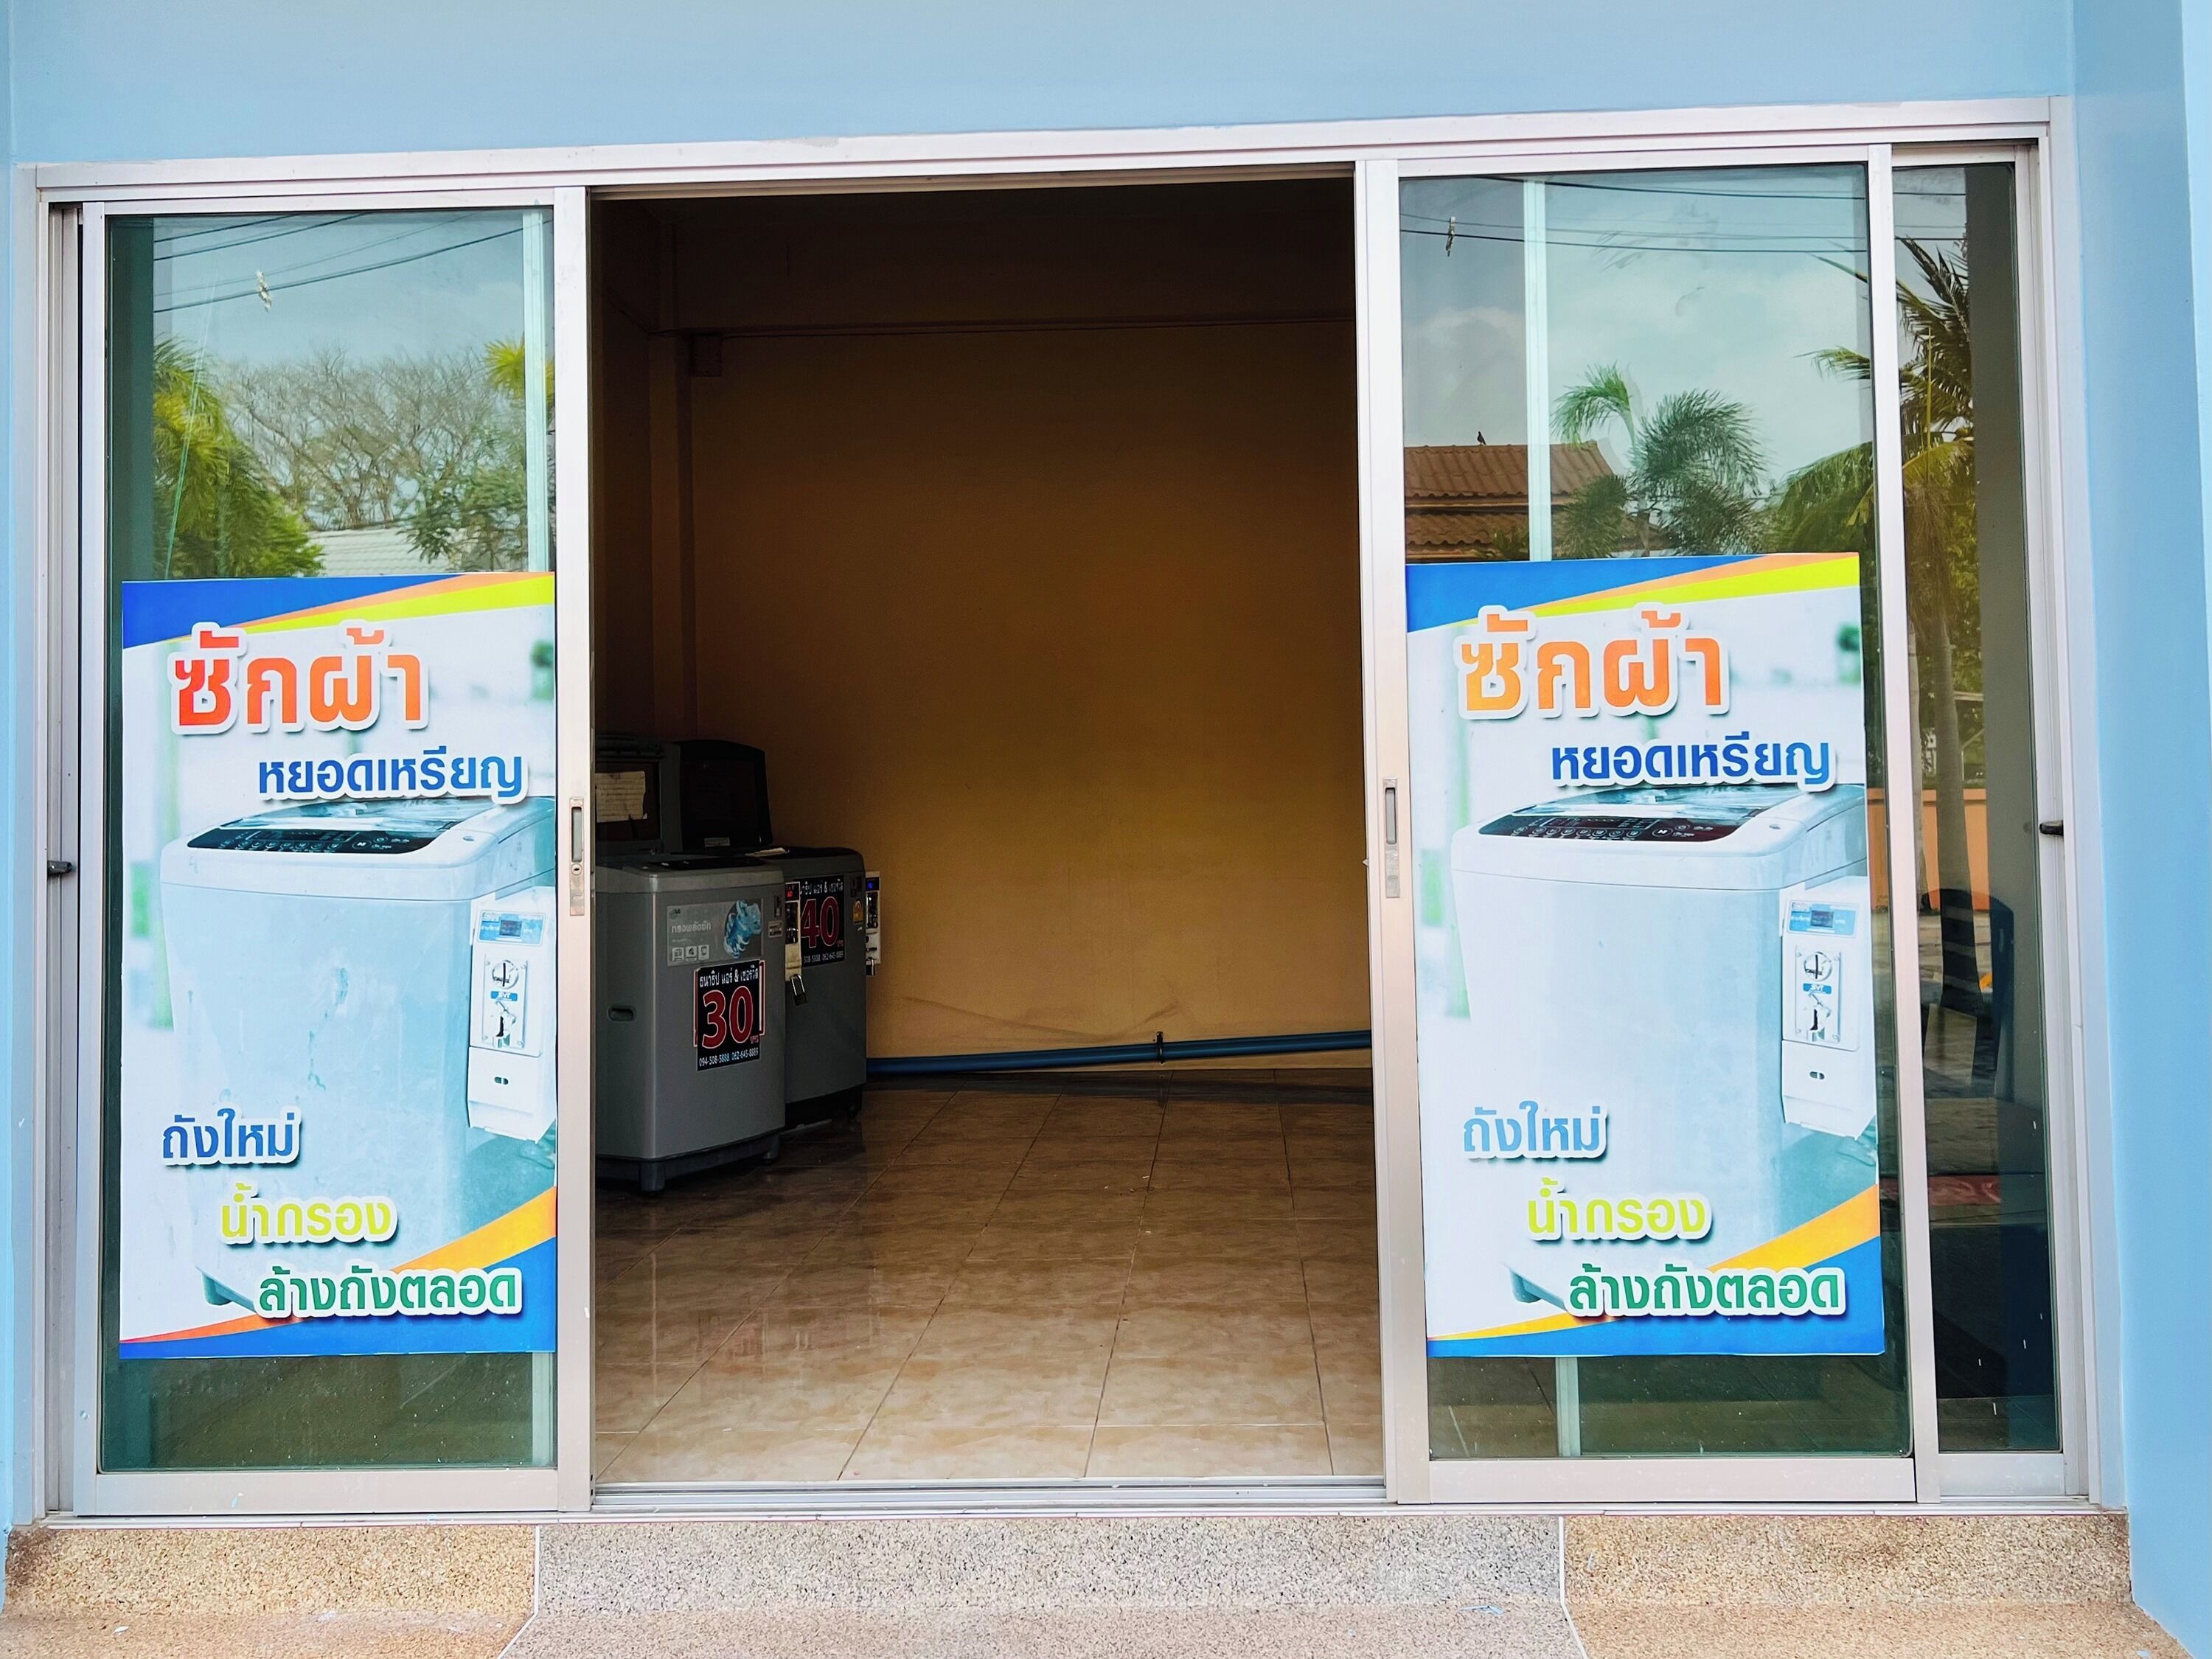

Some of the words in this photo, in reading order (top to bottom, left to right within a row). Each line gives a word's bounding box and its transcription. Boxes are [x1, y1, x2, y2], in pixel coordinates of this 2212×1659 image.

[175, 627, 421, 726] ซักผ้า
[1461, 610, 1722, 712] ซักผ้า
[259, 745, 522, 798] หยอดเหรียญ
[1552, 731, 1829, 785] หยอดเหรียญ
[801, 896, 840, 949] 40
[734, 968, 740, 983] &
[702, 985, 754, 1049] 30
[162, 1108, 294, 1159] ถังใหม่
[1464, 1100, 1601, 1152] ถังใหม่
[221, 1182, 392, 1238] น้ำกรอง
[1528, 1178, 1706, 1234] น้ำกรอง
[260, 1265, 518, 1312] ล้างถังตลอด
[1569, 1263, 1840, 1310] ล้างถังตลอด
